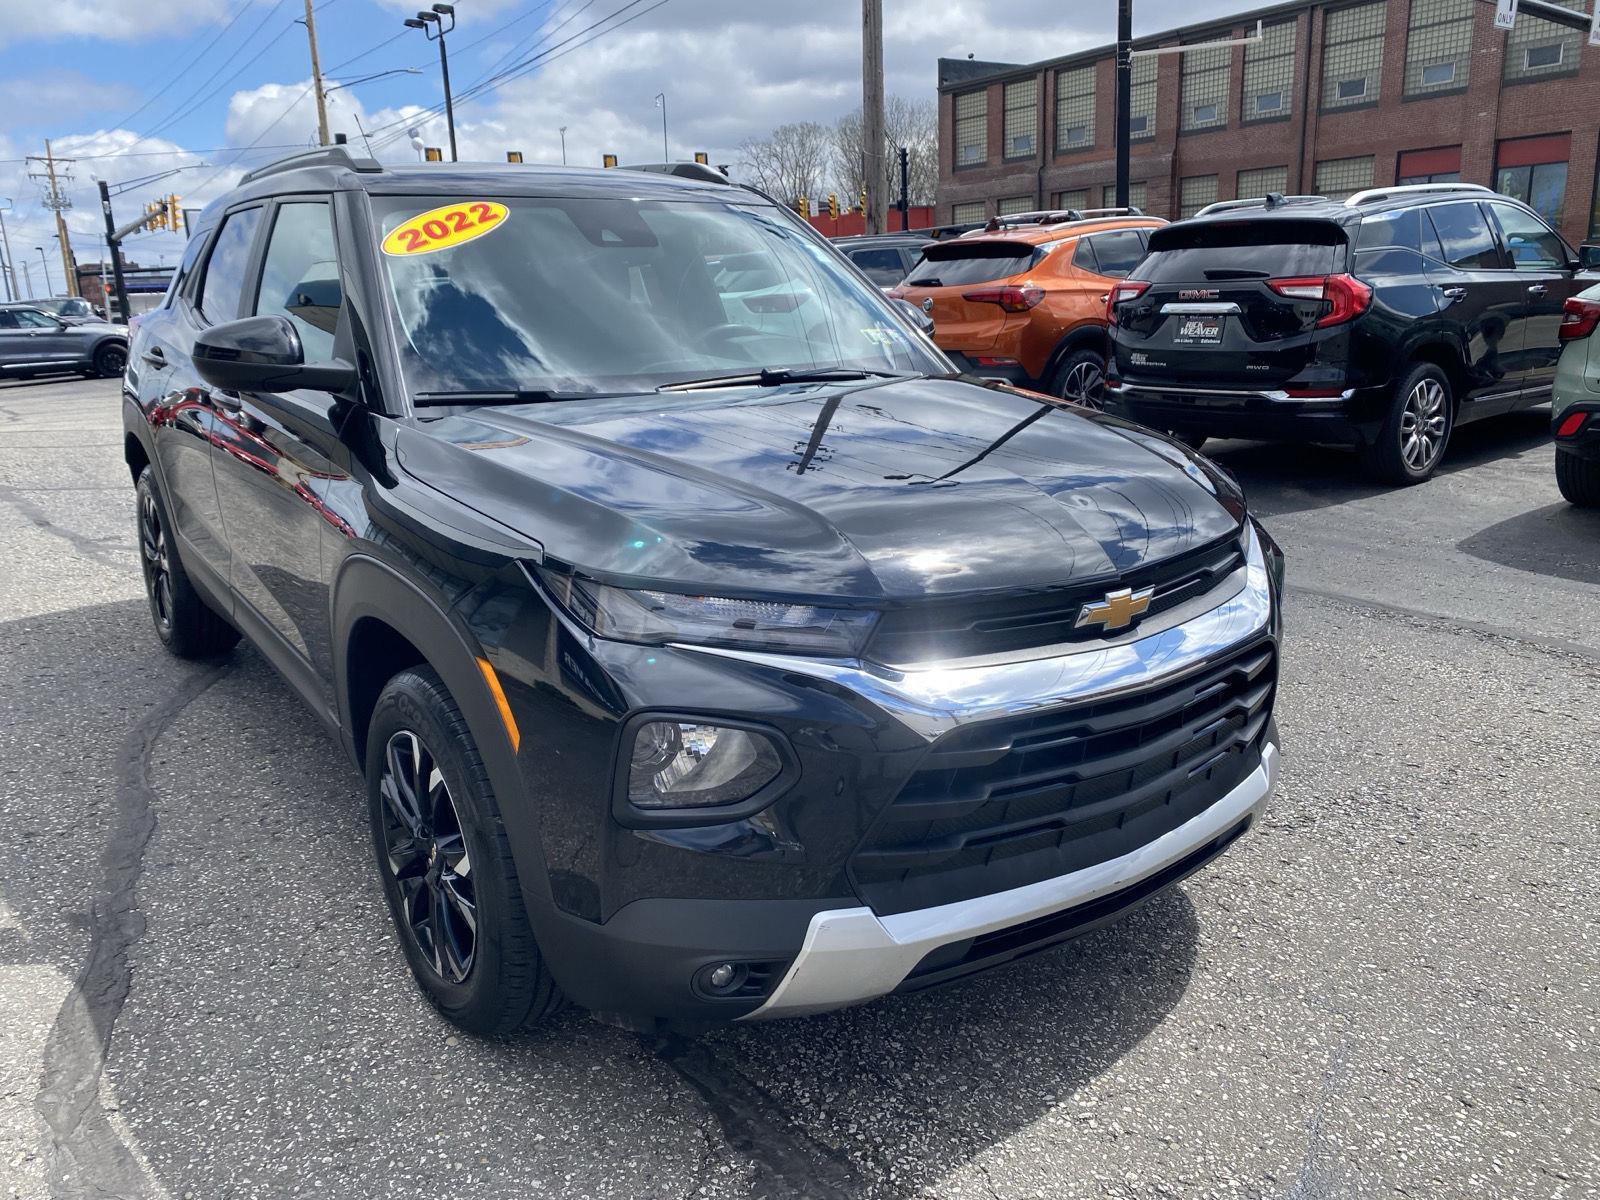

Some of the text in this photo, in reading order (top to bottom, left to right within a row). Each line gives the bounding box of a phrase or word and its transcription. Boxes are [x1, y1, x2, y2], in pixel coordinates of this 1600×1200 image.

[1497, 13, 1513, 24] ONLY
[397, 203, 500, 252] 2022
[1179, 289, 1219, 299] GMC
[1180, 327, 1219, 335] WEAVER
